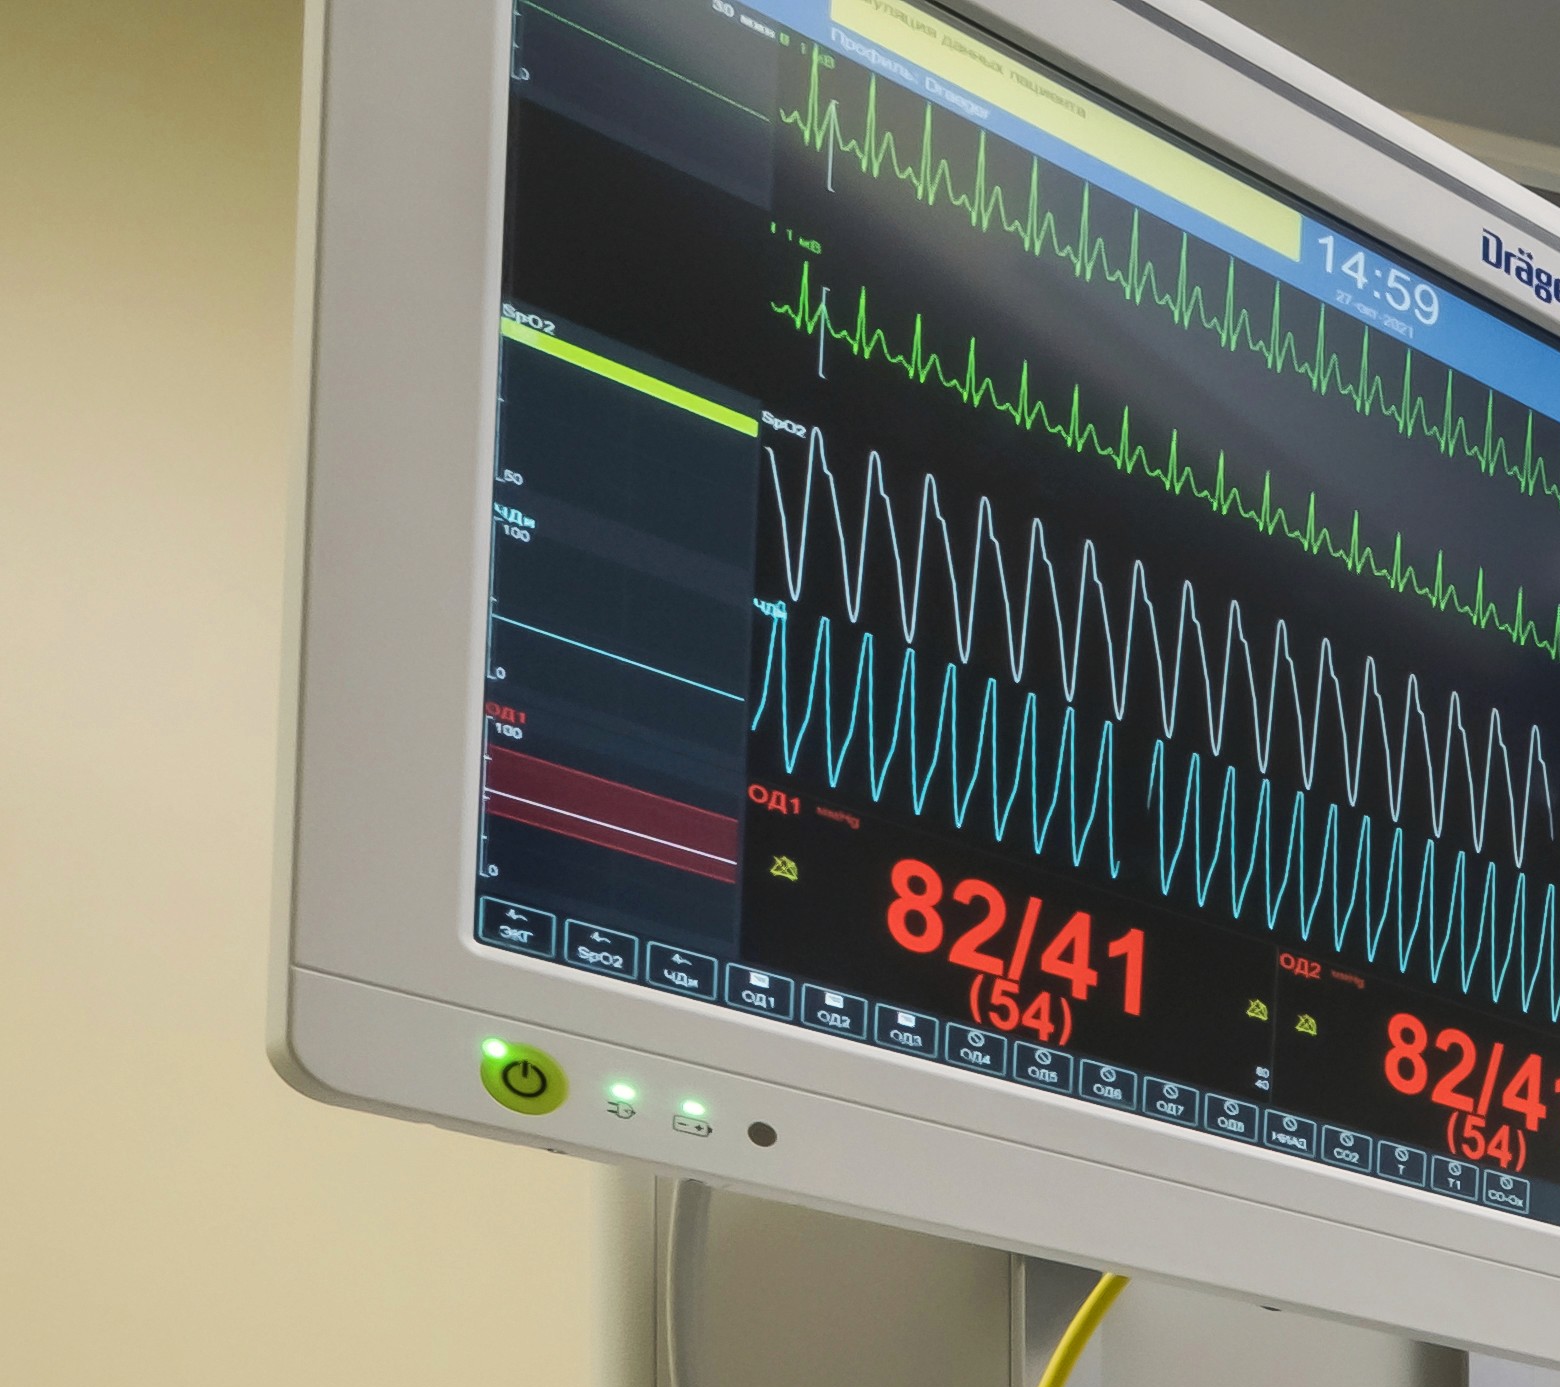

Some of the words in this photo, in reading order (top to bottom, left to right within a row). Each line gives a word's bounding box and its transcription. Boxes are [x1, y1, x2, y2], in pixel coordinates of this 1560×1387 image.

[1317, 234, 1441, 326] 14:59
[501, 303, 556, 337] SpO2
[761, 409, 808, 439] SpO2
[485, 701, 527, 725] ОД1
[494, 722, 523, 740] 100
[747, 783, 802, 817] ОД1
[886, 857, 1146, 1017] 82/41
[577, 944, 624, 970] SpO2
[1278, 952, 1322, 981] ОД2
[741, 989, 776, 1009] ОД1
[969, 972, 1073, 1047] (54)
[816, 1009, 852, 1030] ОД2
[960, 1047, 992, 1066] ОД4
[1155, 1101, 1185, 1118] ОД7
[1445, 1110, 1529, 1173] (54)
